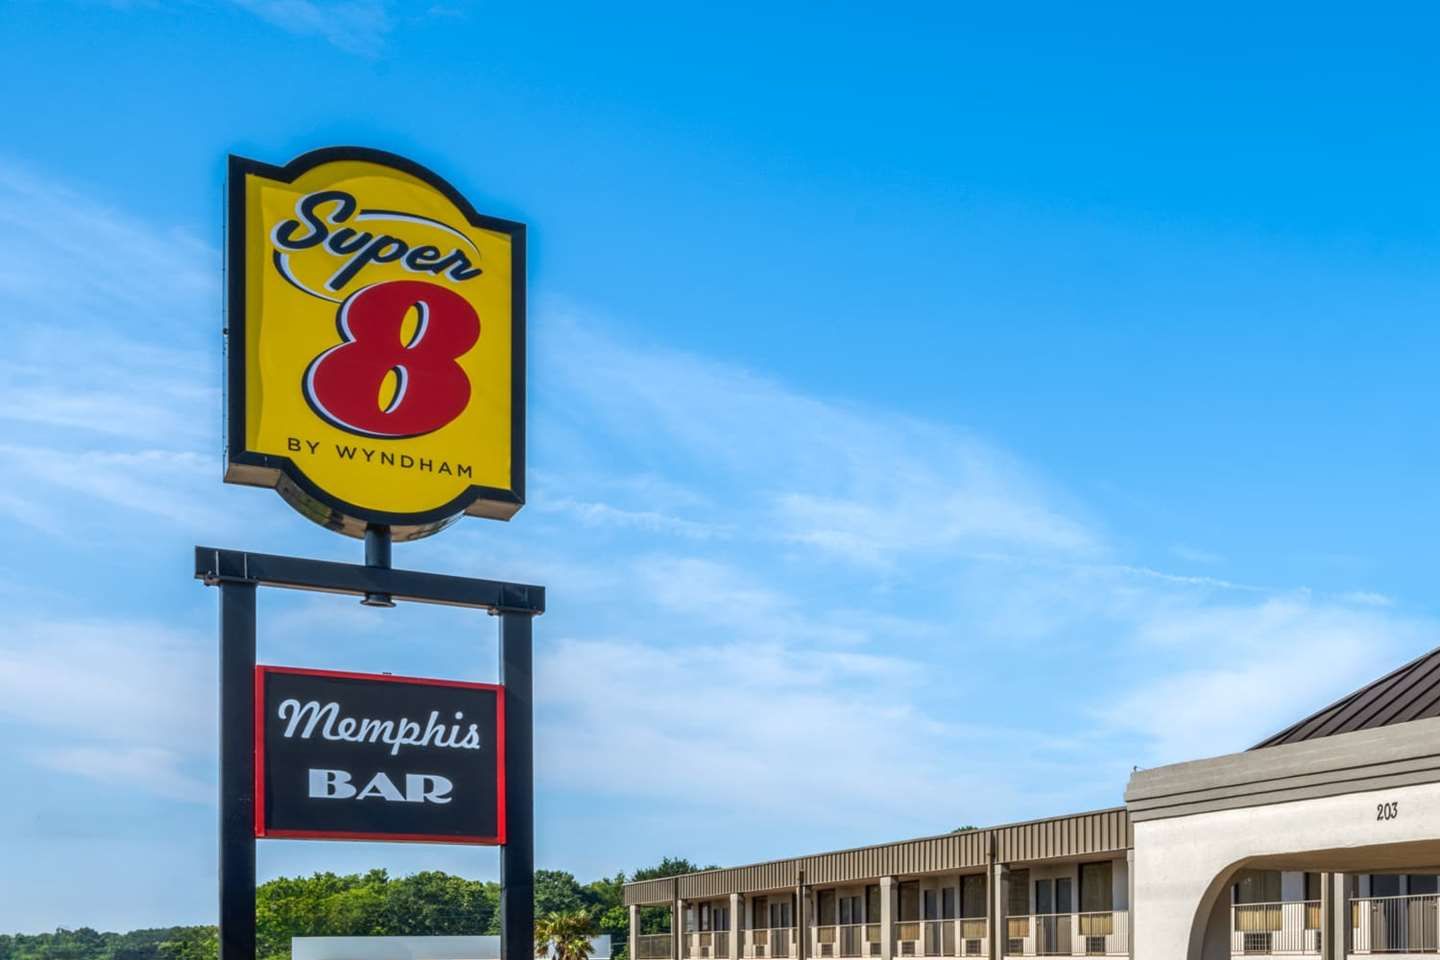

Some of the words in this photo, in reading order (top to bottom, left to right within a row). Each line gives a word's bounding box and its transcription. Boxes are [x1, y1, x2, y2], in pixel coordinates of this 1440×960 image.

[271, 190, 483, 292] Super
[301, 280, 480, 439] 8
[287, 437, 320, 454] BY
[336, 445, 473, 478] WYNDHAM
[278, 699, 480, 755] Memphis
[308, 768, 453, 804] BAR
[1377, 802, 1398, 821] 203
